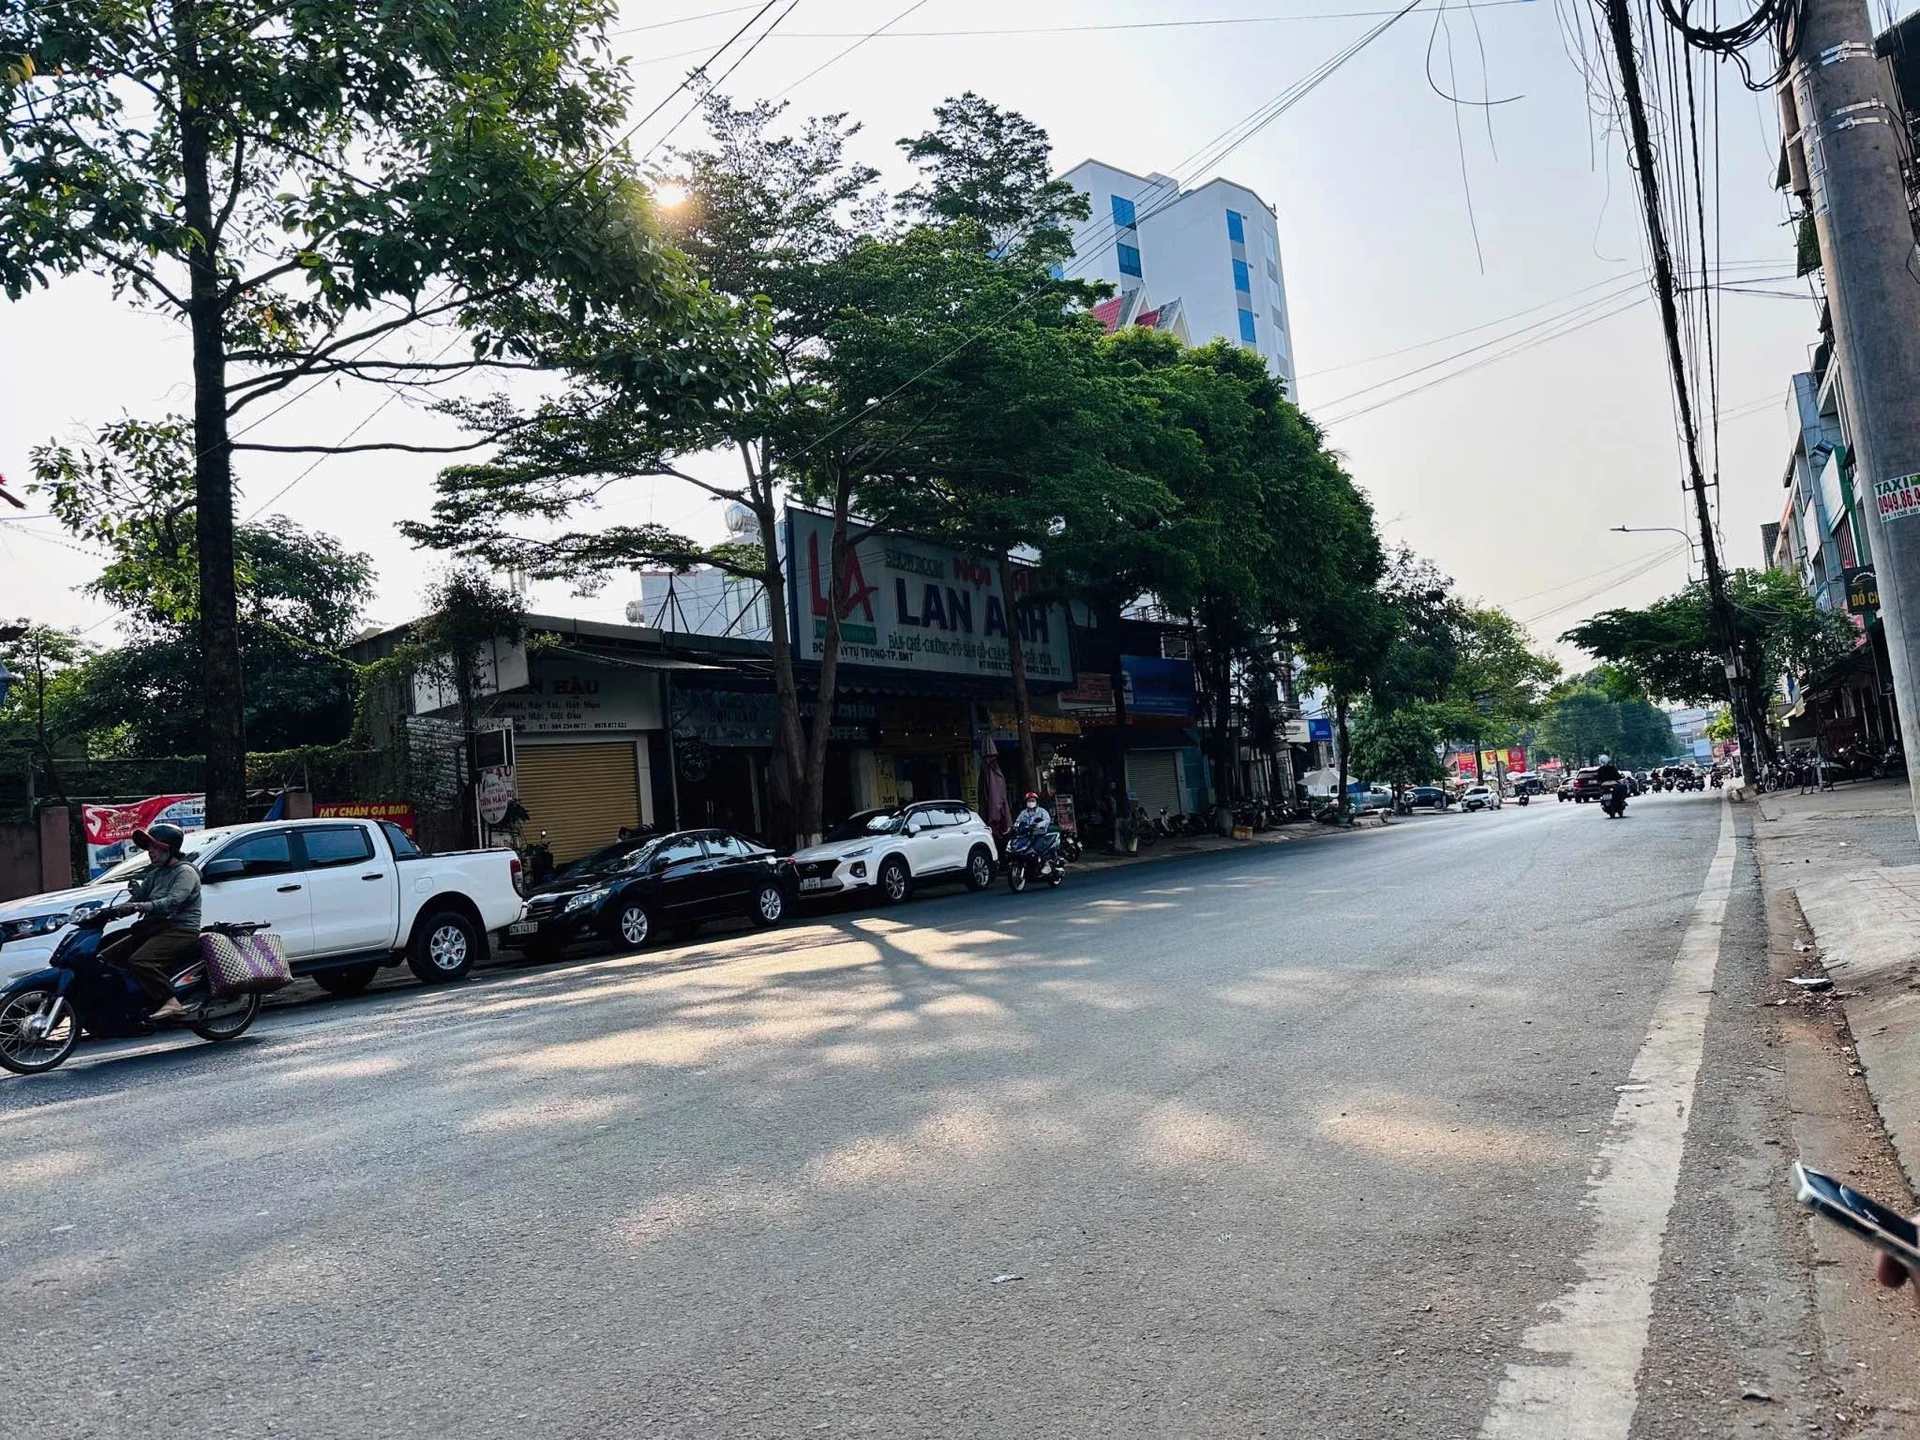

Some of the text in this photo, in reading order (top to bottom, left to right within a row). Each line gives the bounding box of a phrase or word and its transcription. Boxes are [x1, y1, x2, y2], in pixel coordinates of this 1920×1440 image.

[1875, 477, 1909, 495] TAXI
[895, 577, 972, 633] LAN
[554, 676, 599, 699] HẬU
[370, 806, 386, 816] GA
